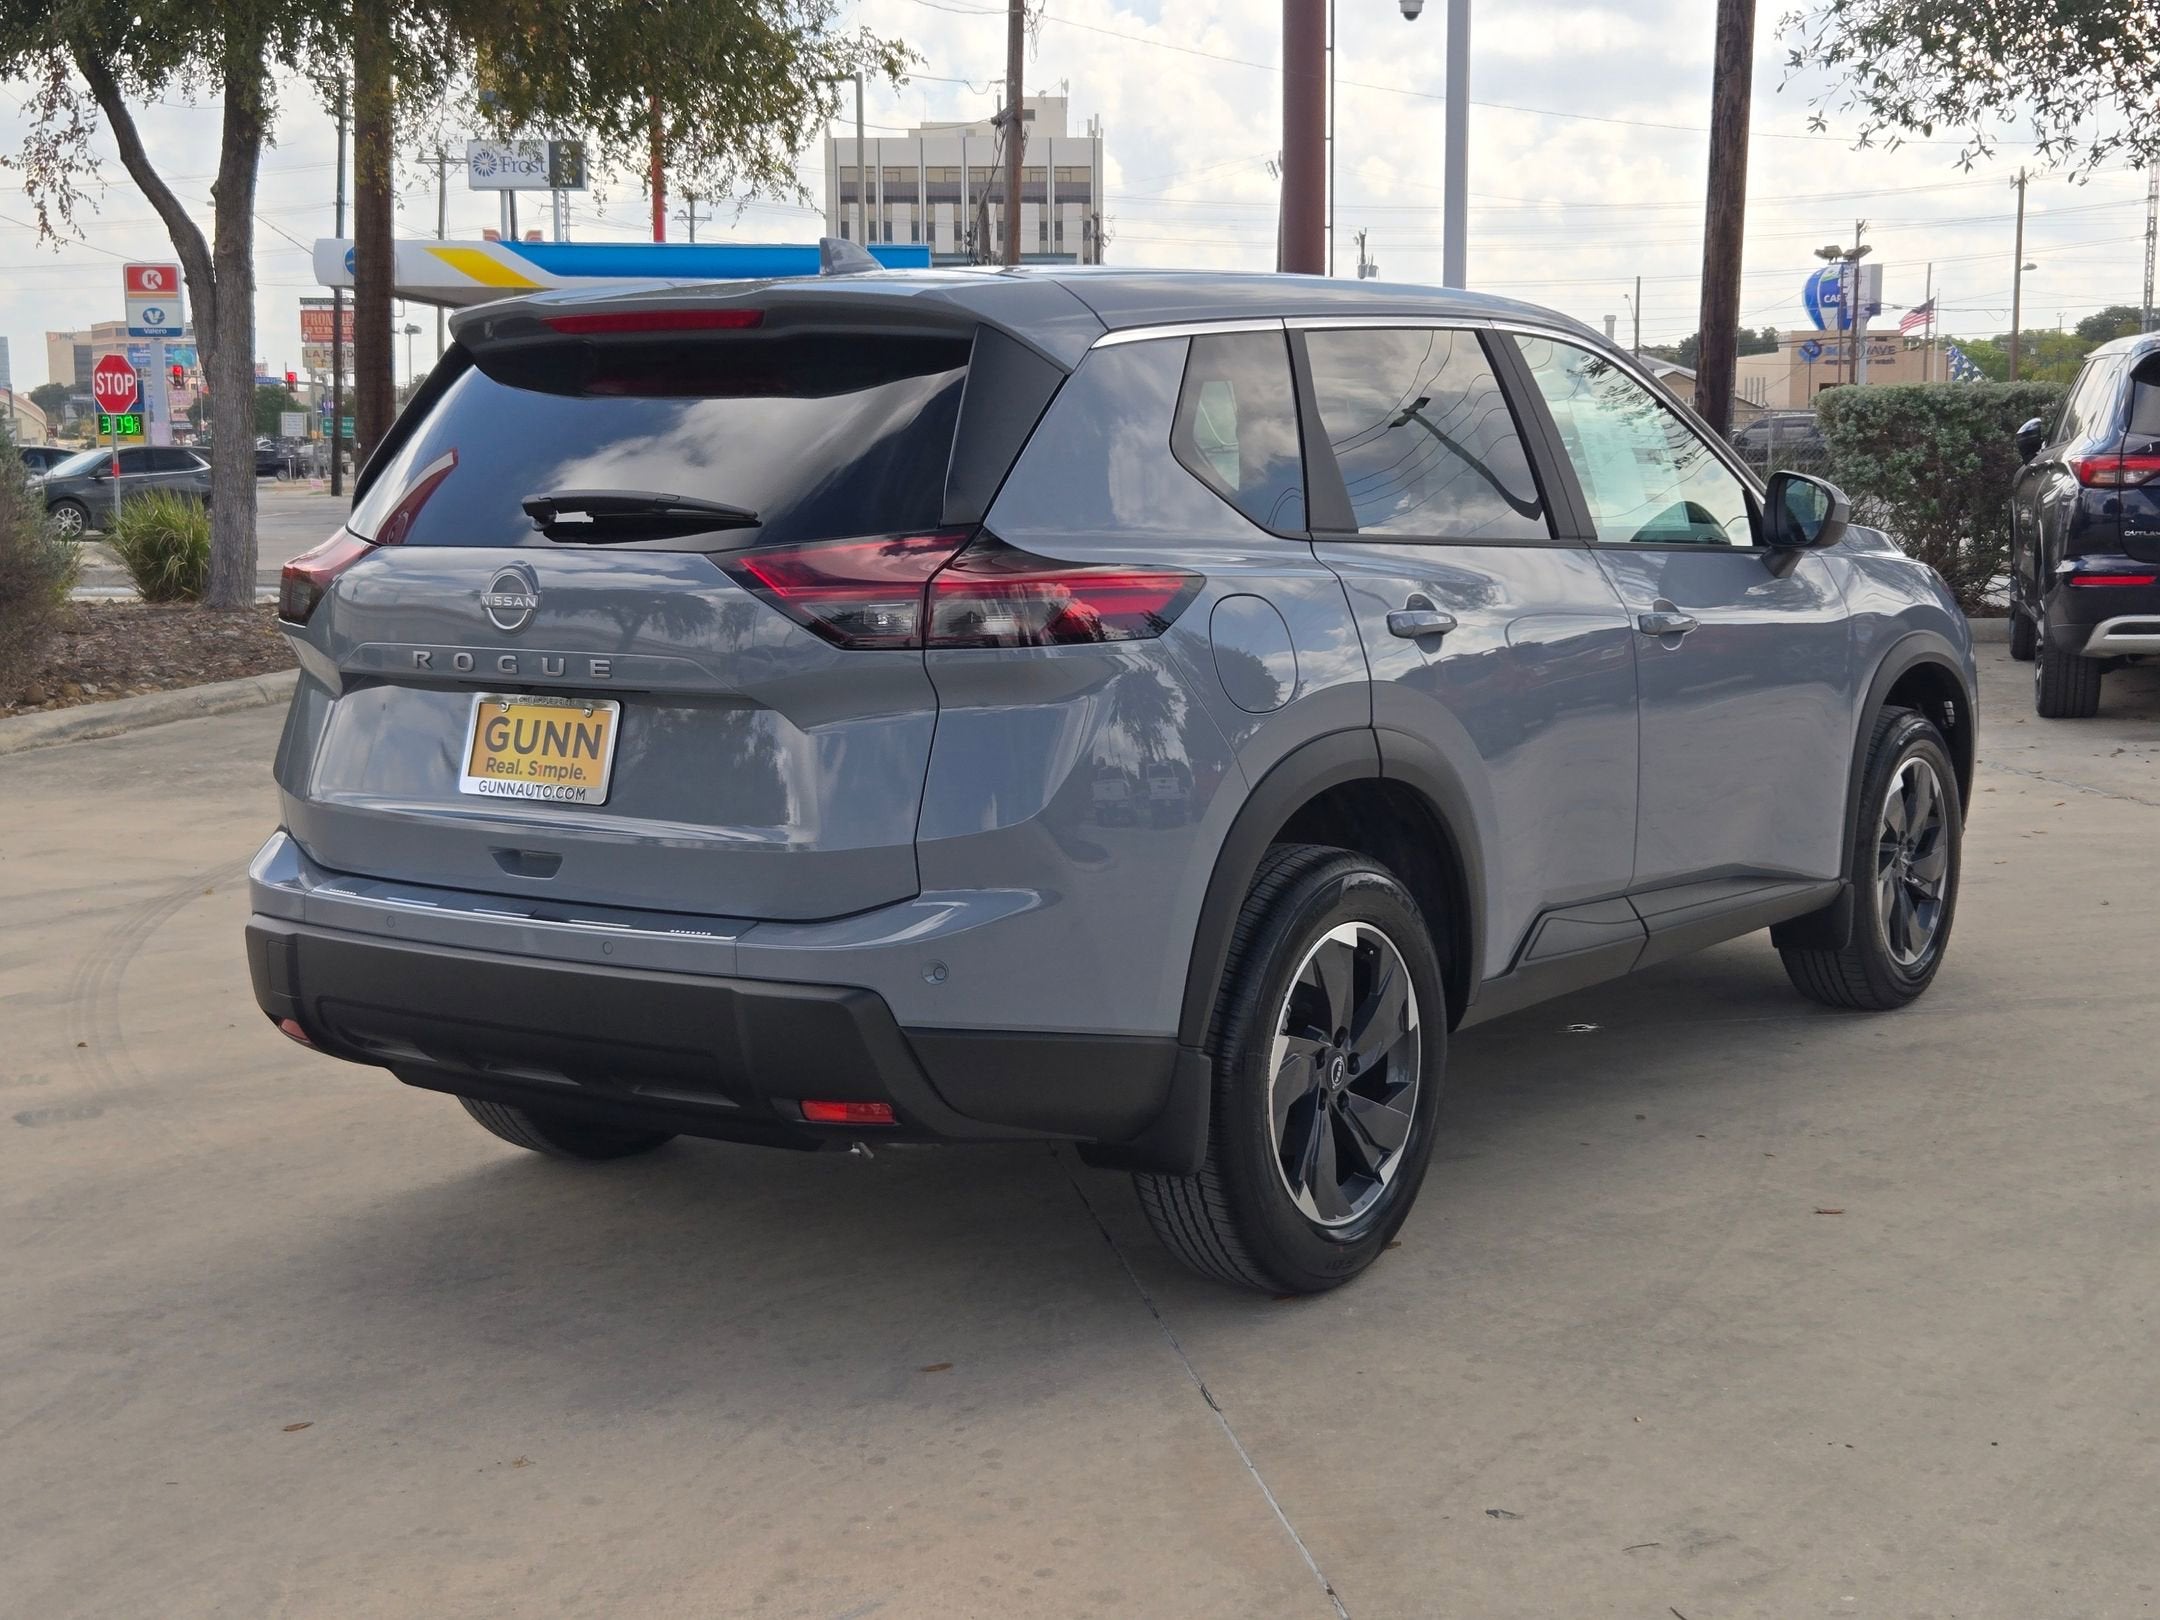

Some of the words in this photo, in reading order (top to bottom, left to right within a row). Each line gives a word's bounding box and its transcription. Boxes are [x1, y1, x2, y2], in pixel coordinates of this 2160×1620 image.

[500, 156, 547, 173] Frost
[96, 372, 134, 396] STOP
[481, 595, 537, 608] NISSAN
[412, 650, 612, 679] ROGUE
[484, 716, 603, 760] GUNN
[485, 757, 523, 775] Real.
[479, 780, 586, 801] GUNNAUTO.COM
